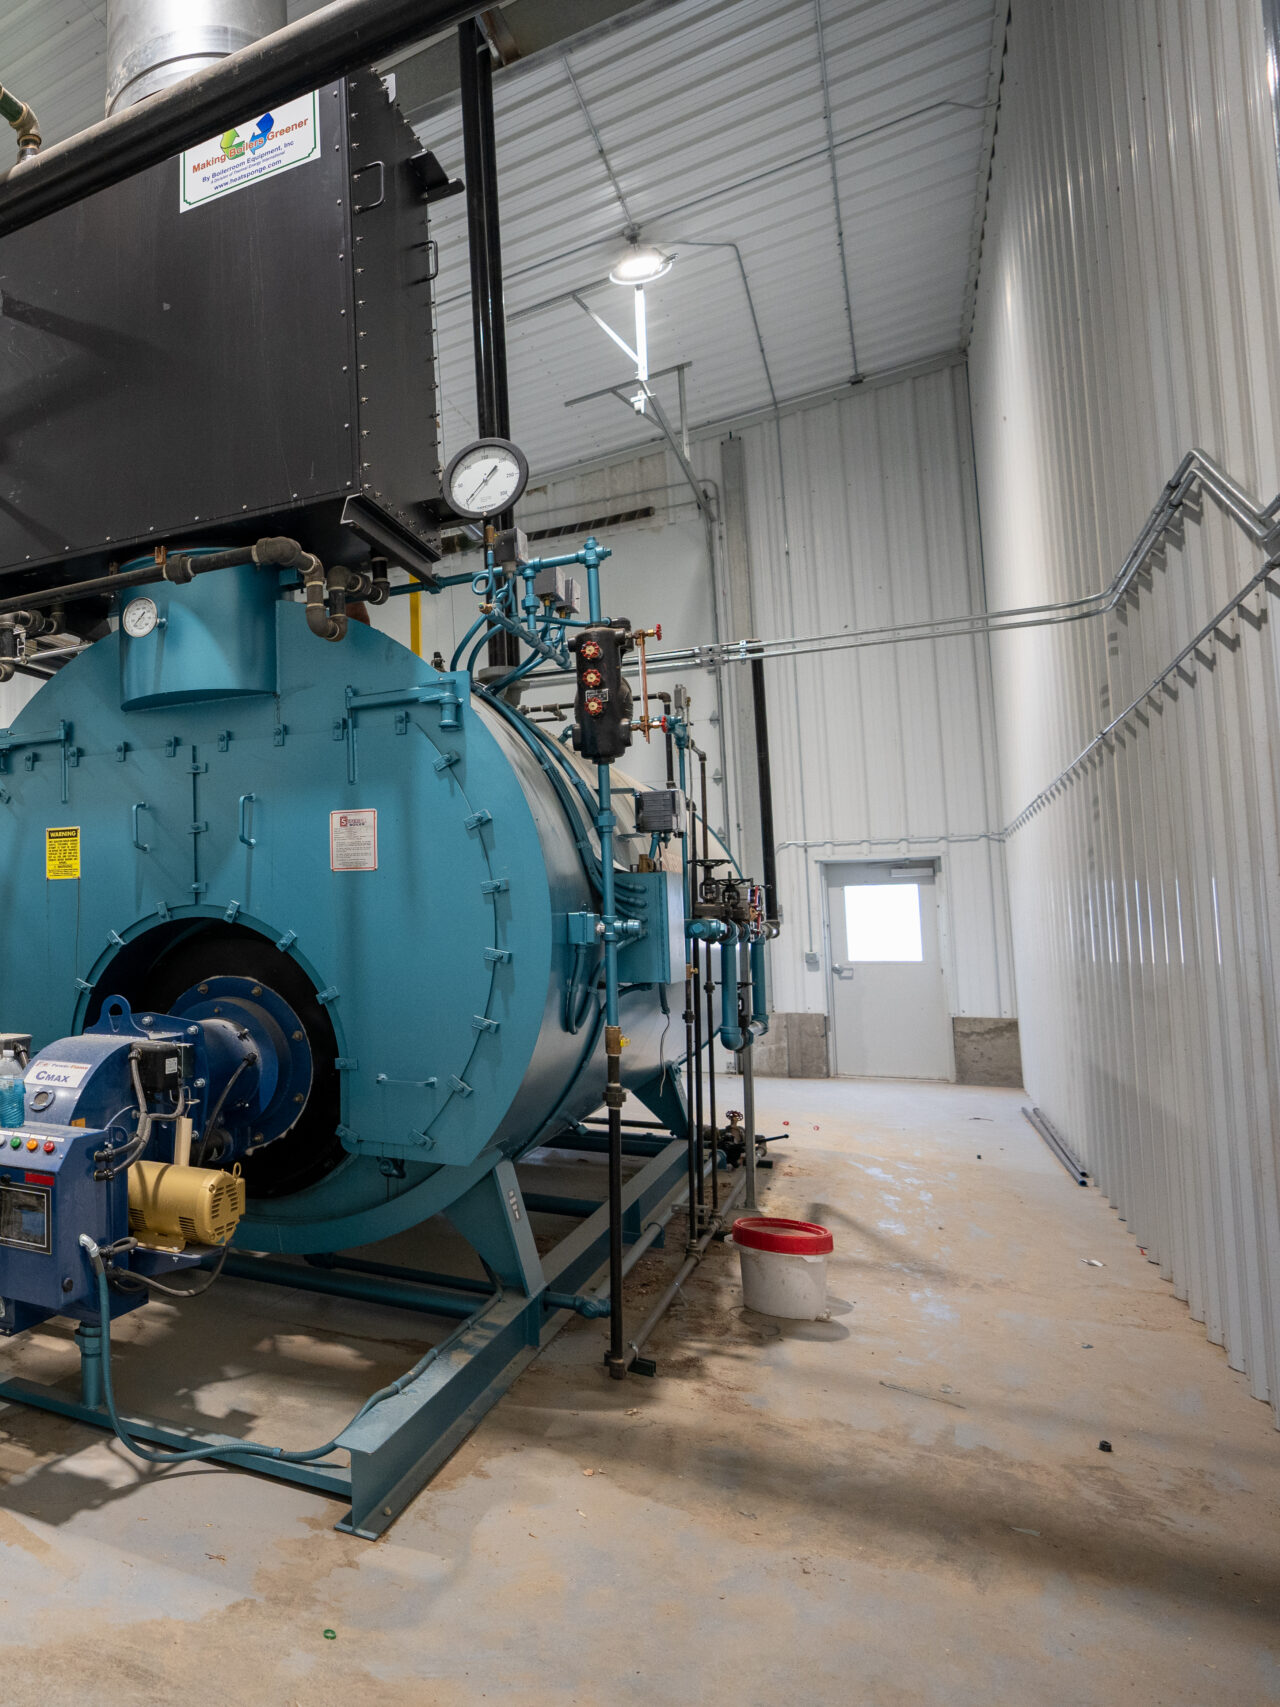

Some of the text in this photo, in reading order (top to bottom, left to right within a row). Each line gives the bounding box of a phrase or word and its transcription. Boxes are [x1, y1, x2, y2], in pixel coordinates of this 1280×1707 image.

[192, 118, 308, 174] Making Boilers Greener
[202, 140, 295, 183] By Boilerroom Equipment, Inc
[214, 159, 282, 190] www.heatsponge.com
